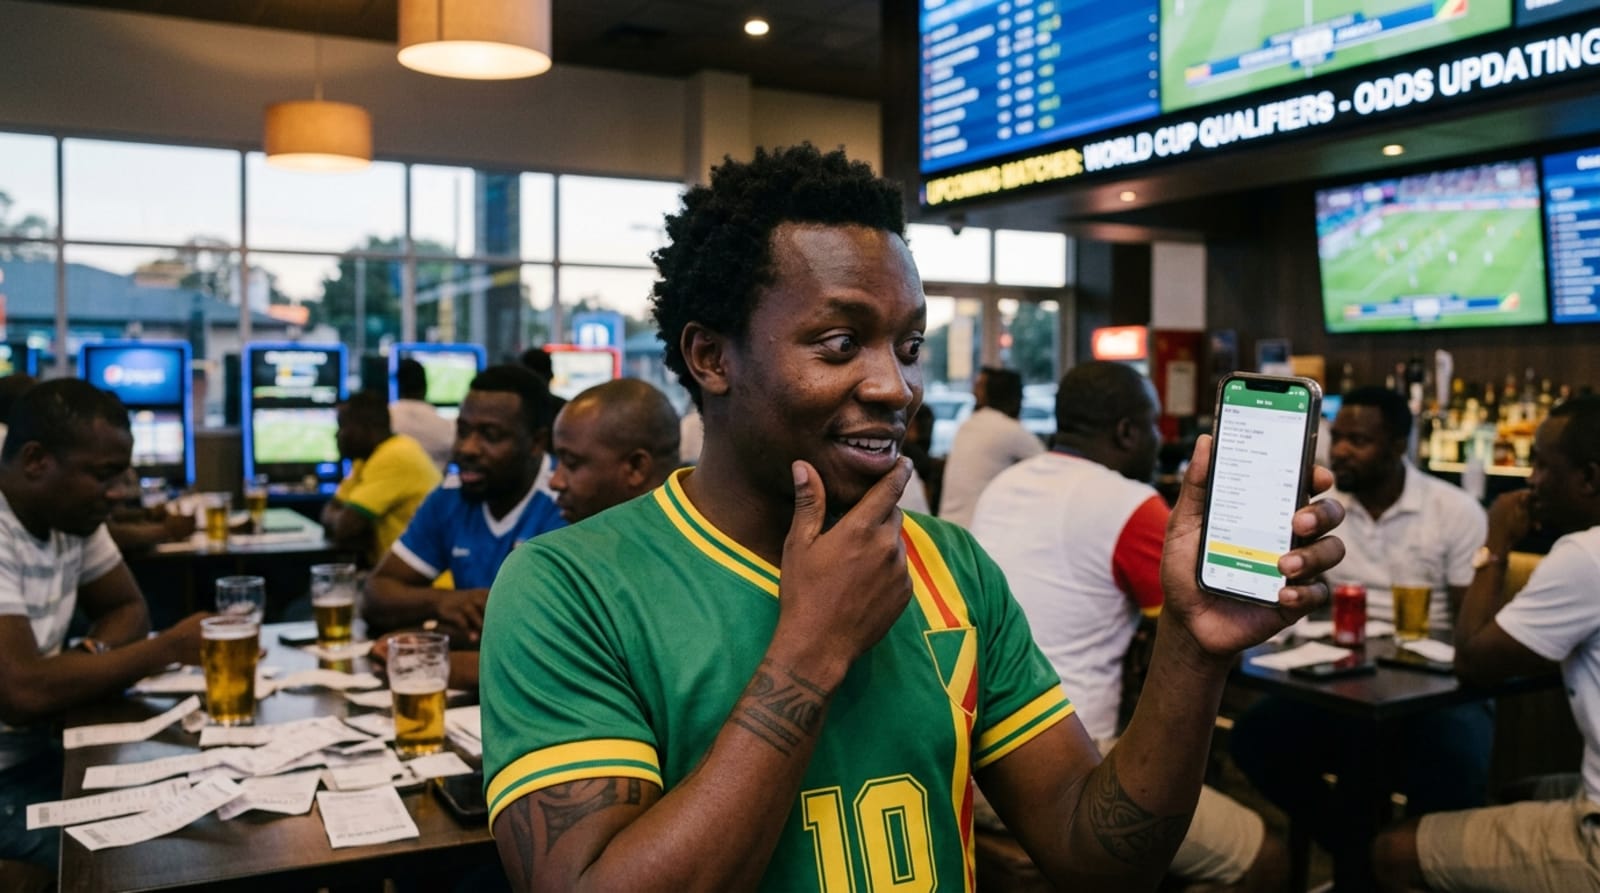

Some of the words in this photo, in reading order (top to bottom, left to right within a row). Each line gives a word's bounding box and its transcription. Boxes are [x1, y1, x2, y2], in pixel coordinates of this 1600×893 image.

[927, 166, 1000, 205] UPCOMING
[1083, 132, 1152, 172] WORLD
[1154, 121, 1198, 157] CUP
[1199, 90, 1336, 148] QUALIFIERS
[1338, 100, 1352, 112] -
[1354, 68, 1435, 115] ODDS
[1439, 27, 1600, 97] UPDATING
[801, 773, 938, 893] 10
